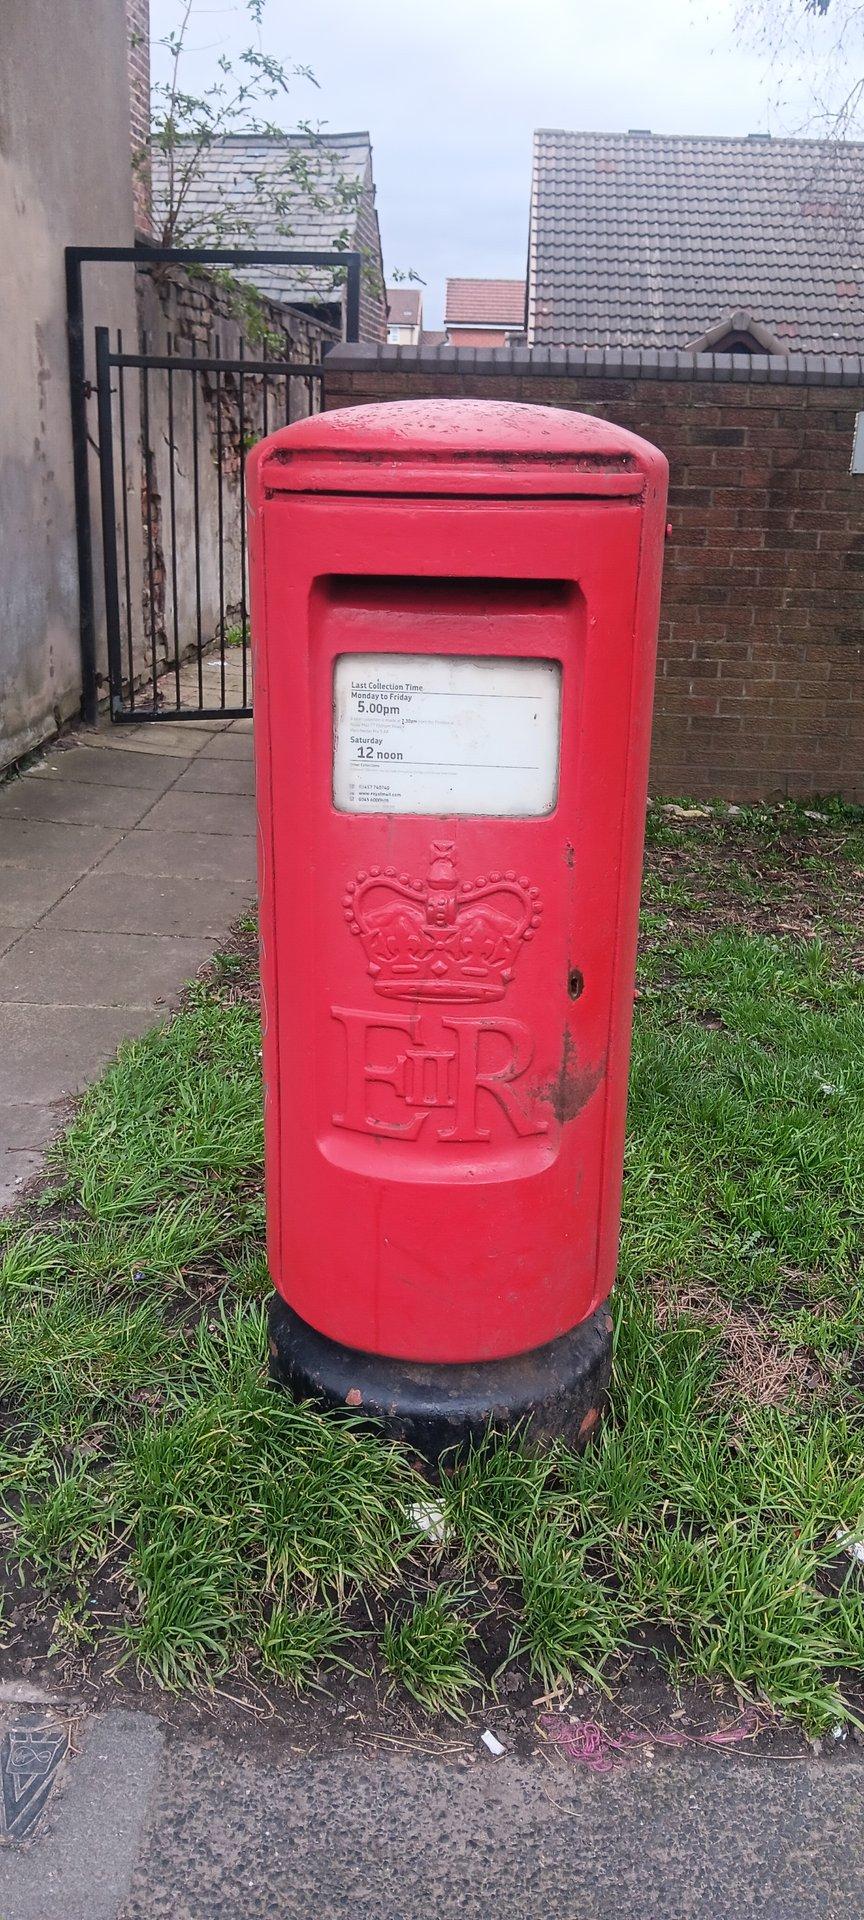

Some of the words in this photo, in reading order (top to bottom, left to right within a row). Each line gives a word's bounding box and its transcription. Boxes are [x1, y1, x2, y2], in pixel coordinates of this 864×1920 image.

[368, 682, 404, 691] Collection
[405, 683, 424, 692] Time
[351, 692, 379, 701] Monday
[389, 693, 412, 702] Friday
[357, 701, 400, 716] 5.00pm
[350, 736, 383, 746] Saturday
[357, 746, 374, 759] 12
[377, 751, 404, 760] noon
